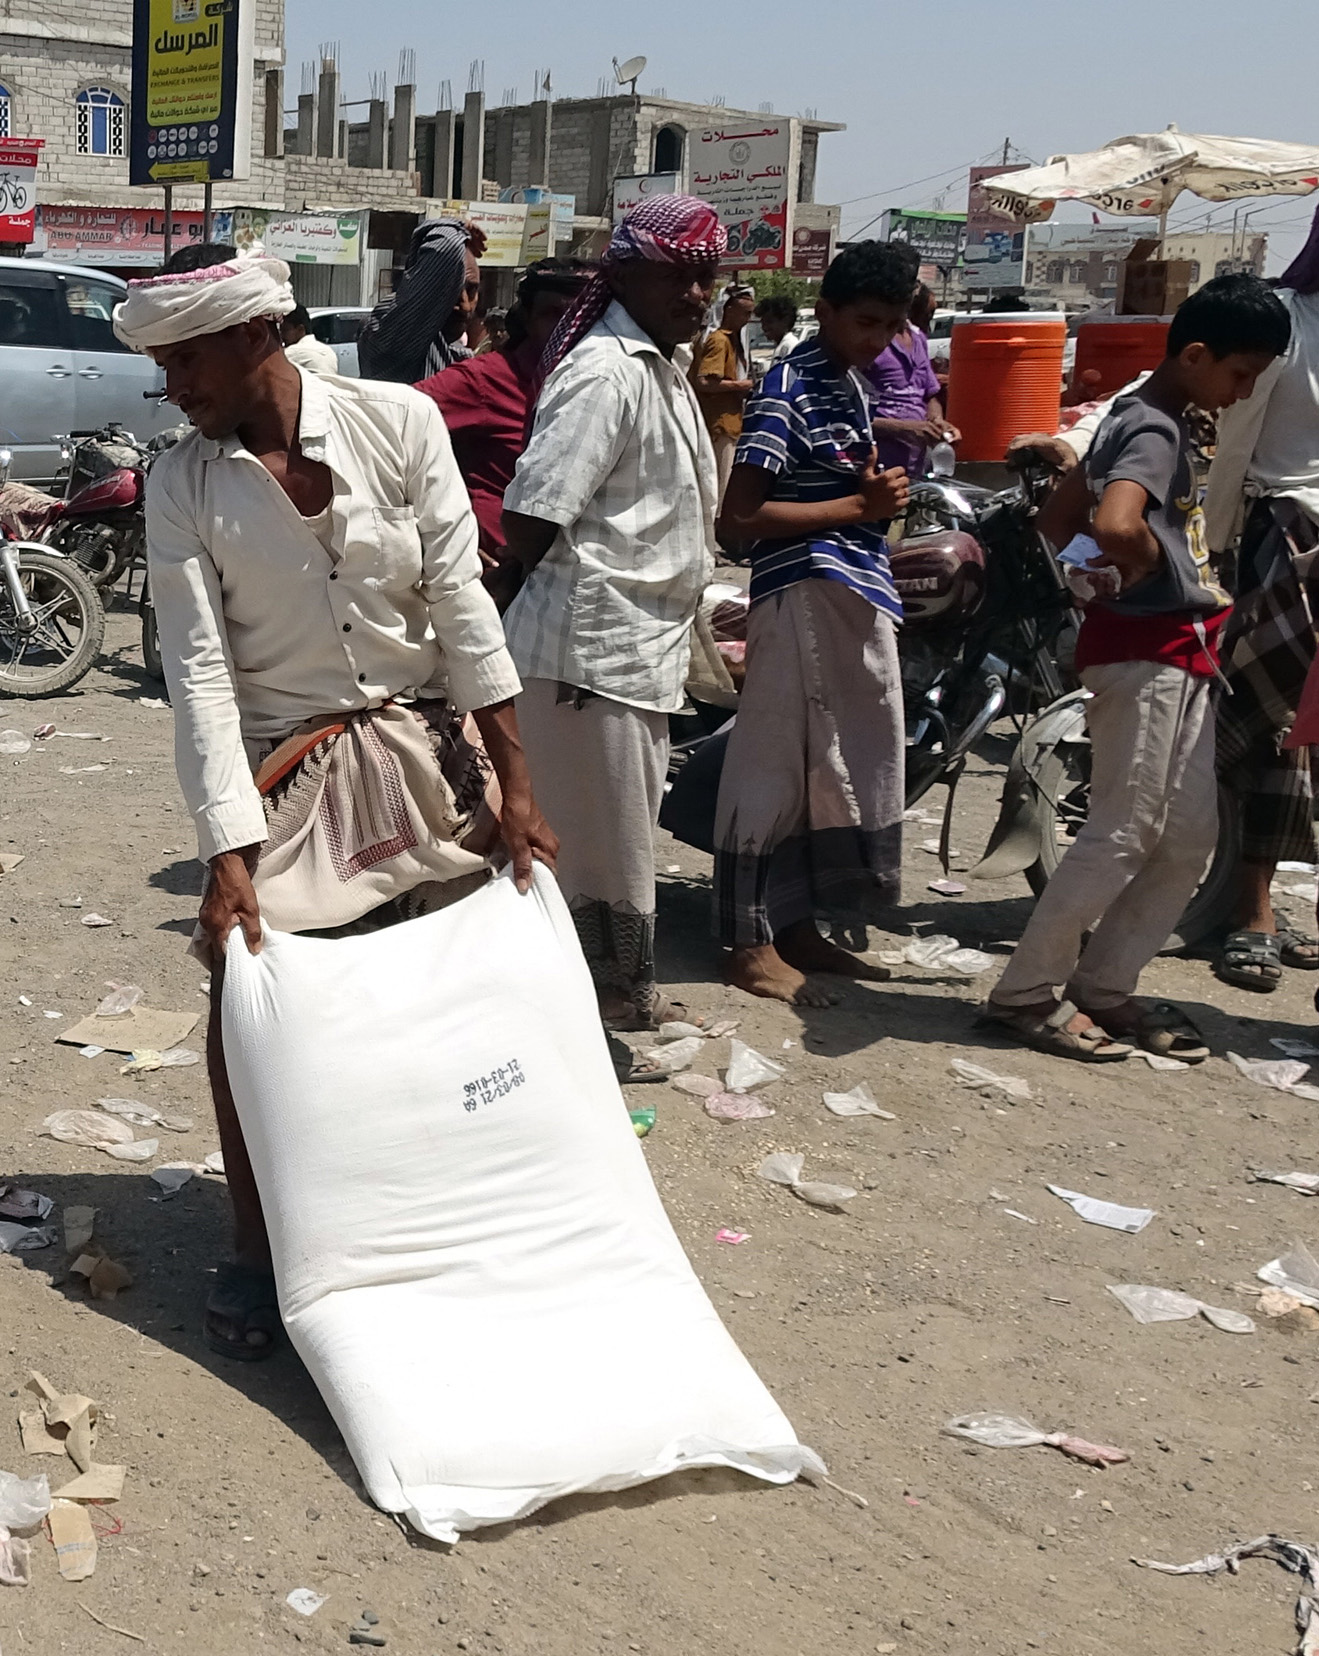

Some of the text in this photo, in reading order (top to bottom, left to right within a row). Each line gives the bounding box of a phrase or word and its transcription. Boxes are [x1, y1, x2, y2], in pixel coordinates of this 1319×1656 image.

[154, 23, 218, 56] المرسل
[701, 127, 779, 143] محلات
[693, 165, 786, 186] الملكي التجارية
[50, 230, 114, 241] ABU AMMAR
[463, 1058, 521, 1098] 21-03-0166
